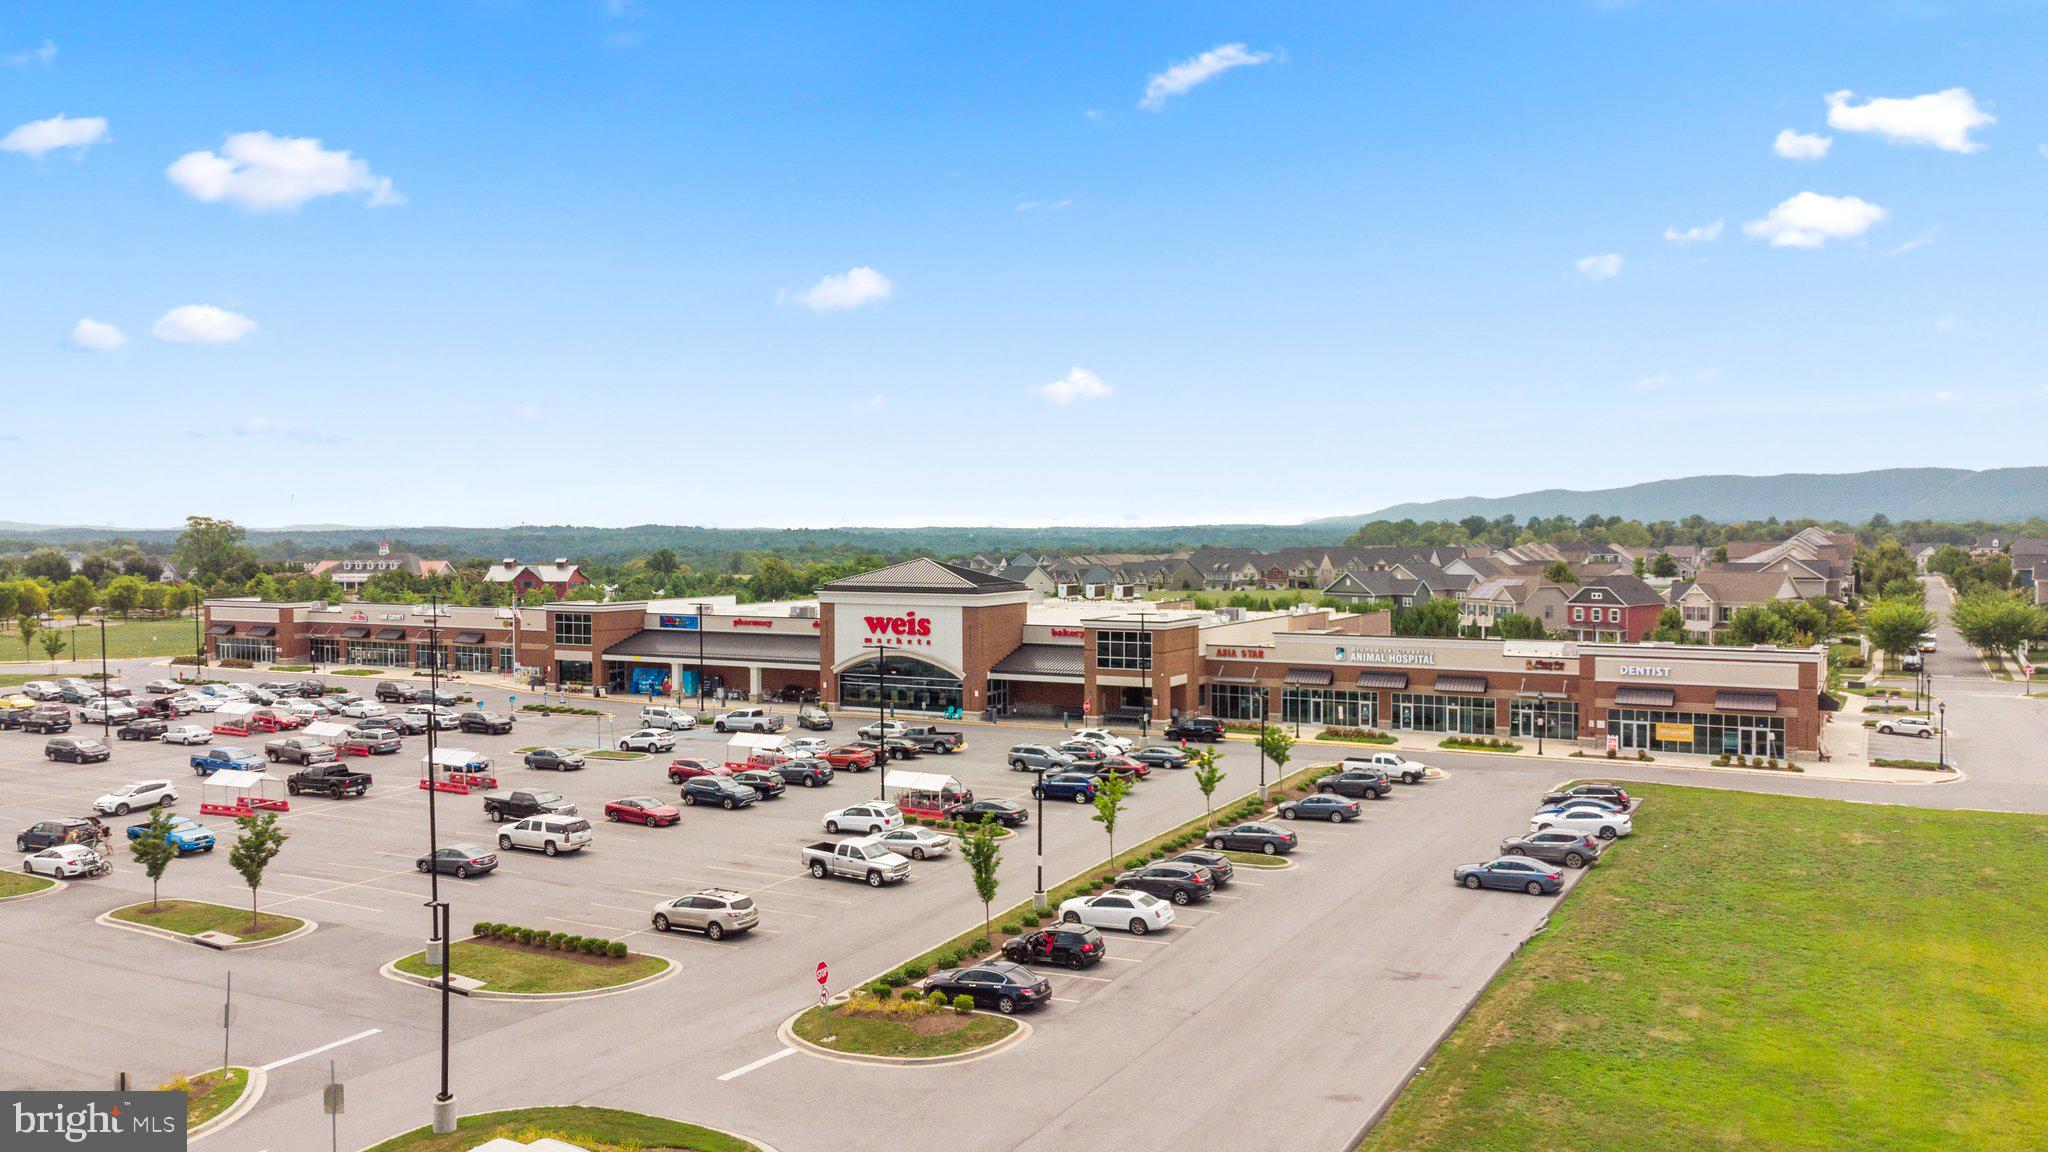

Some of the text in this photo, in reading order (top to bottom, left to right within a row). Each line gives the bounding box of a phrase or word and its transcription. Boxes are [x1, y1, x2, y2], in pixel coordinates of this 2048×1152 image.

[732, 618, 773, 628] pharmacy
[864, 611, 931, 636] weis
[1051, 628, 1085, 639] bakery
[864, 637, 931, 645] markets
[1216, 648, 1264, 659] ASIA STAR
[1350, 652, 1435, 664] ANIMAL HOSPITAL
[1620, 665, 1671, 677] DENTIST
[816, 966, 829, 979] STOP
